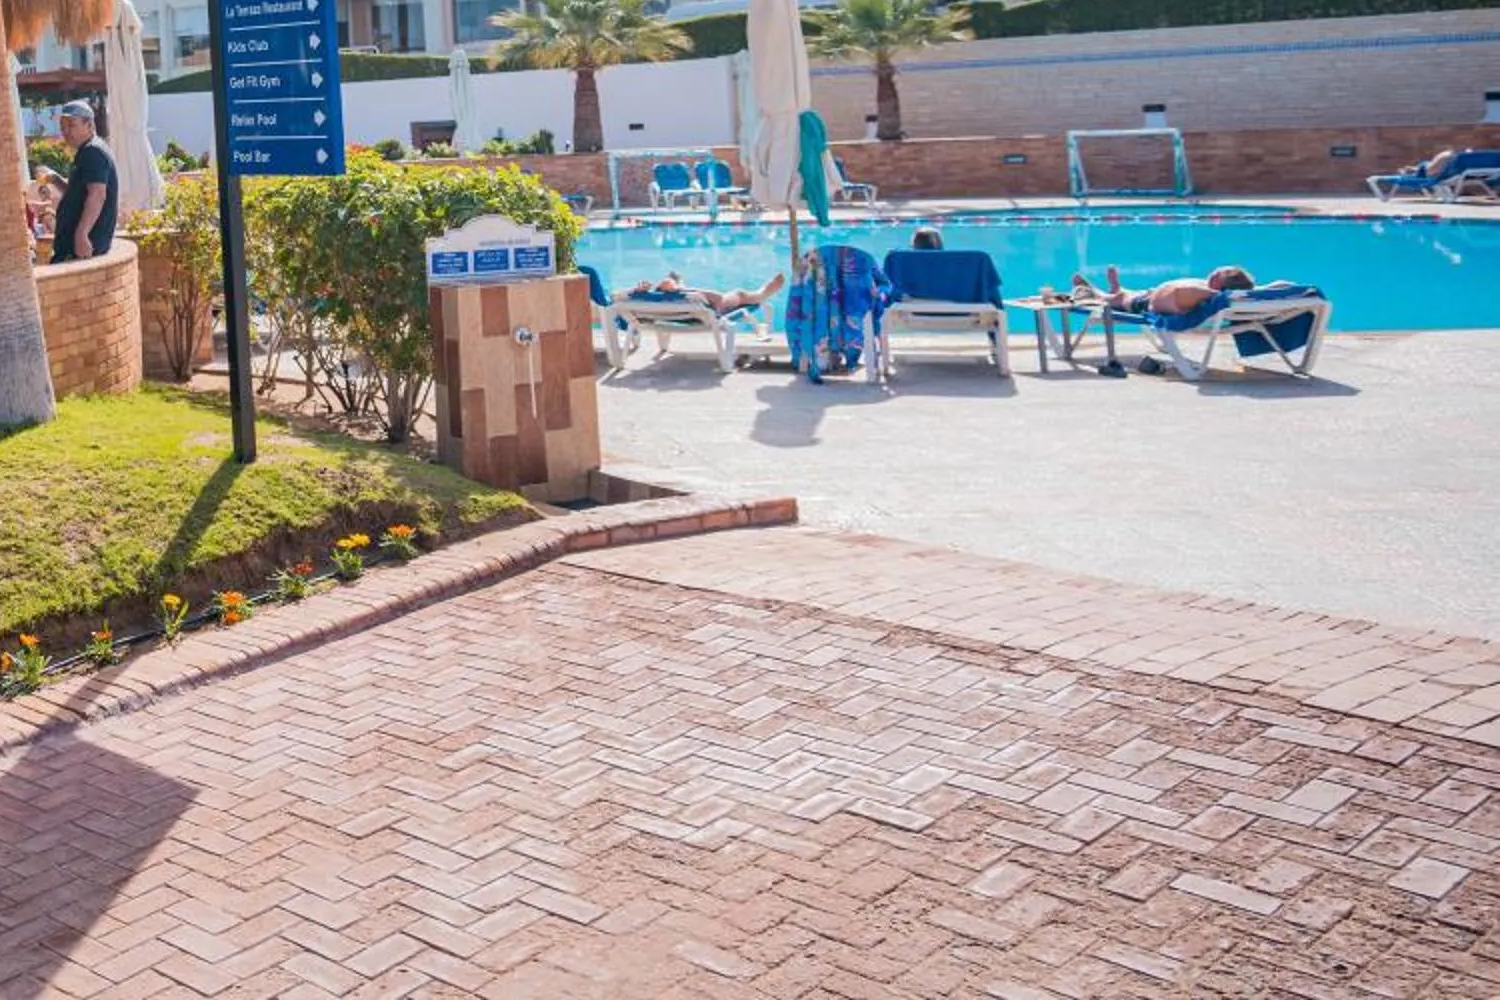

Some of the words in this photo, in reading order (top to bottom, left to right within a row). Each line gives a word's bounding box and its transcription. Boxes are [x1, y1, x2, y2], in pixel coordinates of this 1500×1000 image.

[227, 40, 247, 53] Kids
[247, 39, 269, 52] Club
[229, 76, 245, 89] Get
[260, 75, 281, 90] Gym
[257, 112, 277, 126] Pool
[233, 149, 253, 163] Pool
[254, 149, 271, 162] Bar
